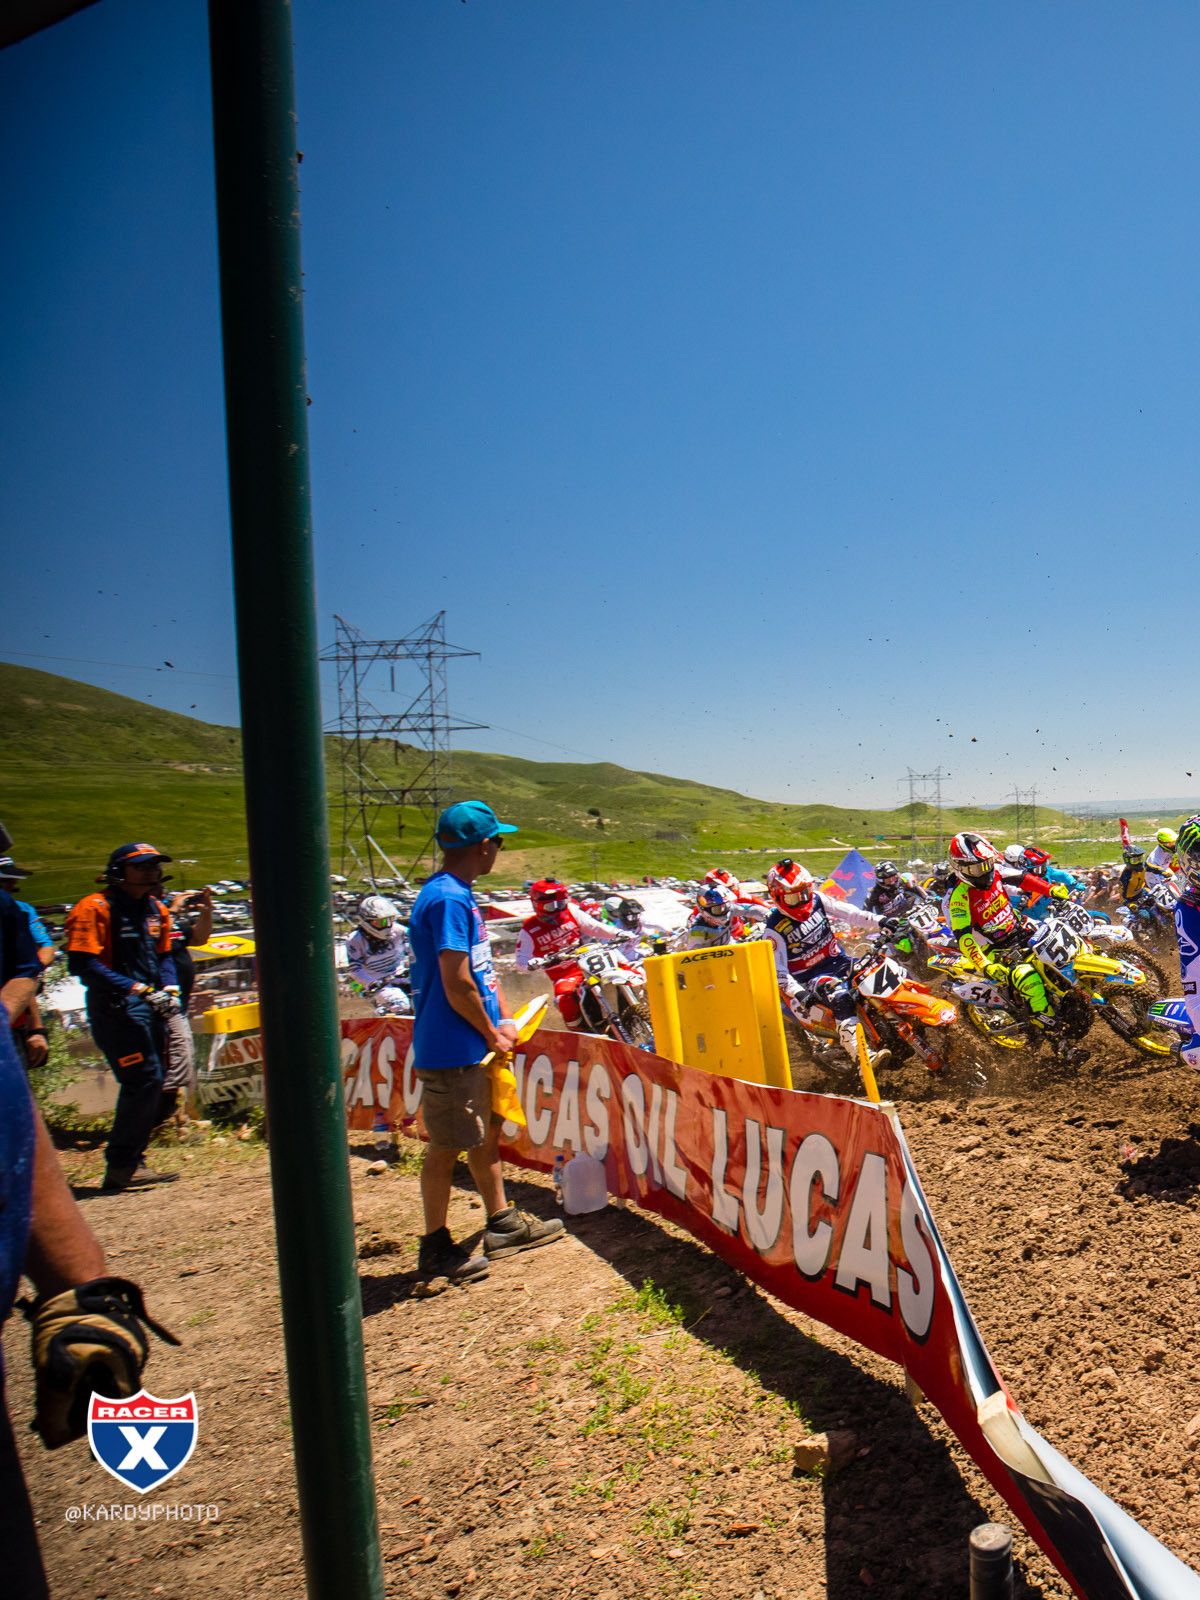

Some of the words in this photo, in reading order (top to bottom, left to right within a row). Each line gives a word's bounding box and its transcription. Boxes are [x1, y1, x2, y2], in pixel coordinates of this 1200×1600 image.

[786, 928, 802, 943] FLY
[800, 908, 825, 935] RACIN
[983, 904, 1012, 931] SUZU
[536, 933, 552, 946] FLY
[1046, 927, 1078, 967] 54
[586, 952, 615, 975] 81
[680, 950, 734, 964] ACERBIS
[873, 962, 901, 995] 4
[971, 986, 992, 1003] 54
[1153, 1016, 1178, 1028] DUNLOP
[340, 1035, 396, 1110] CAS
[502, 1053, 612, 1161] CAS
[620, 1073, 688, 1201] OIL
[711, 1107, 935, 1345] LUCAS
